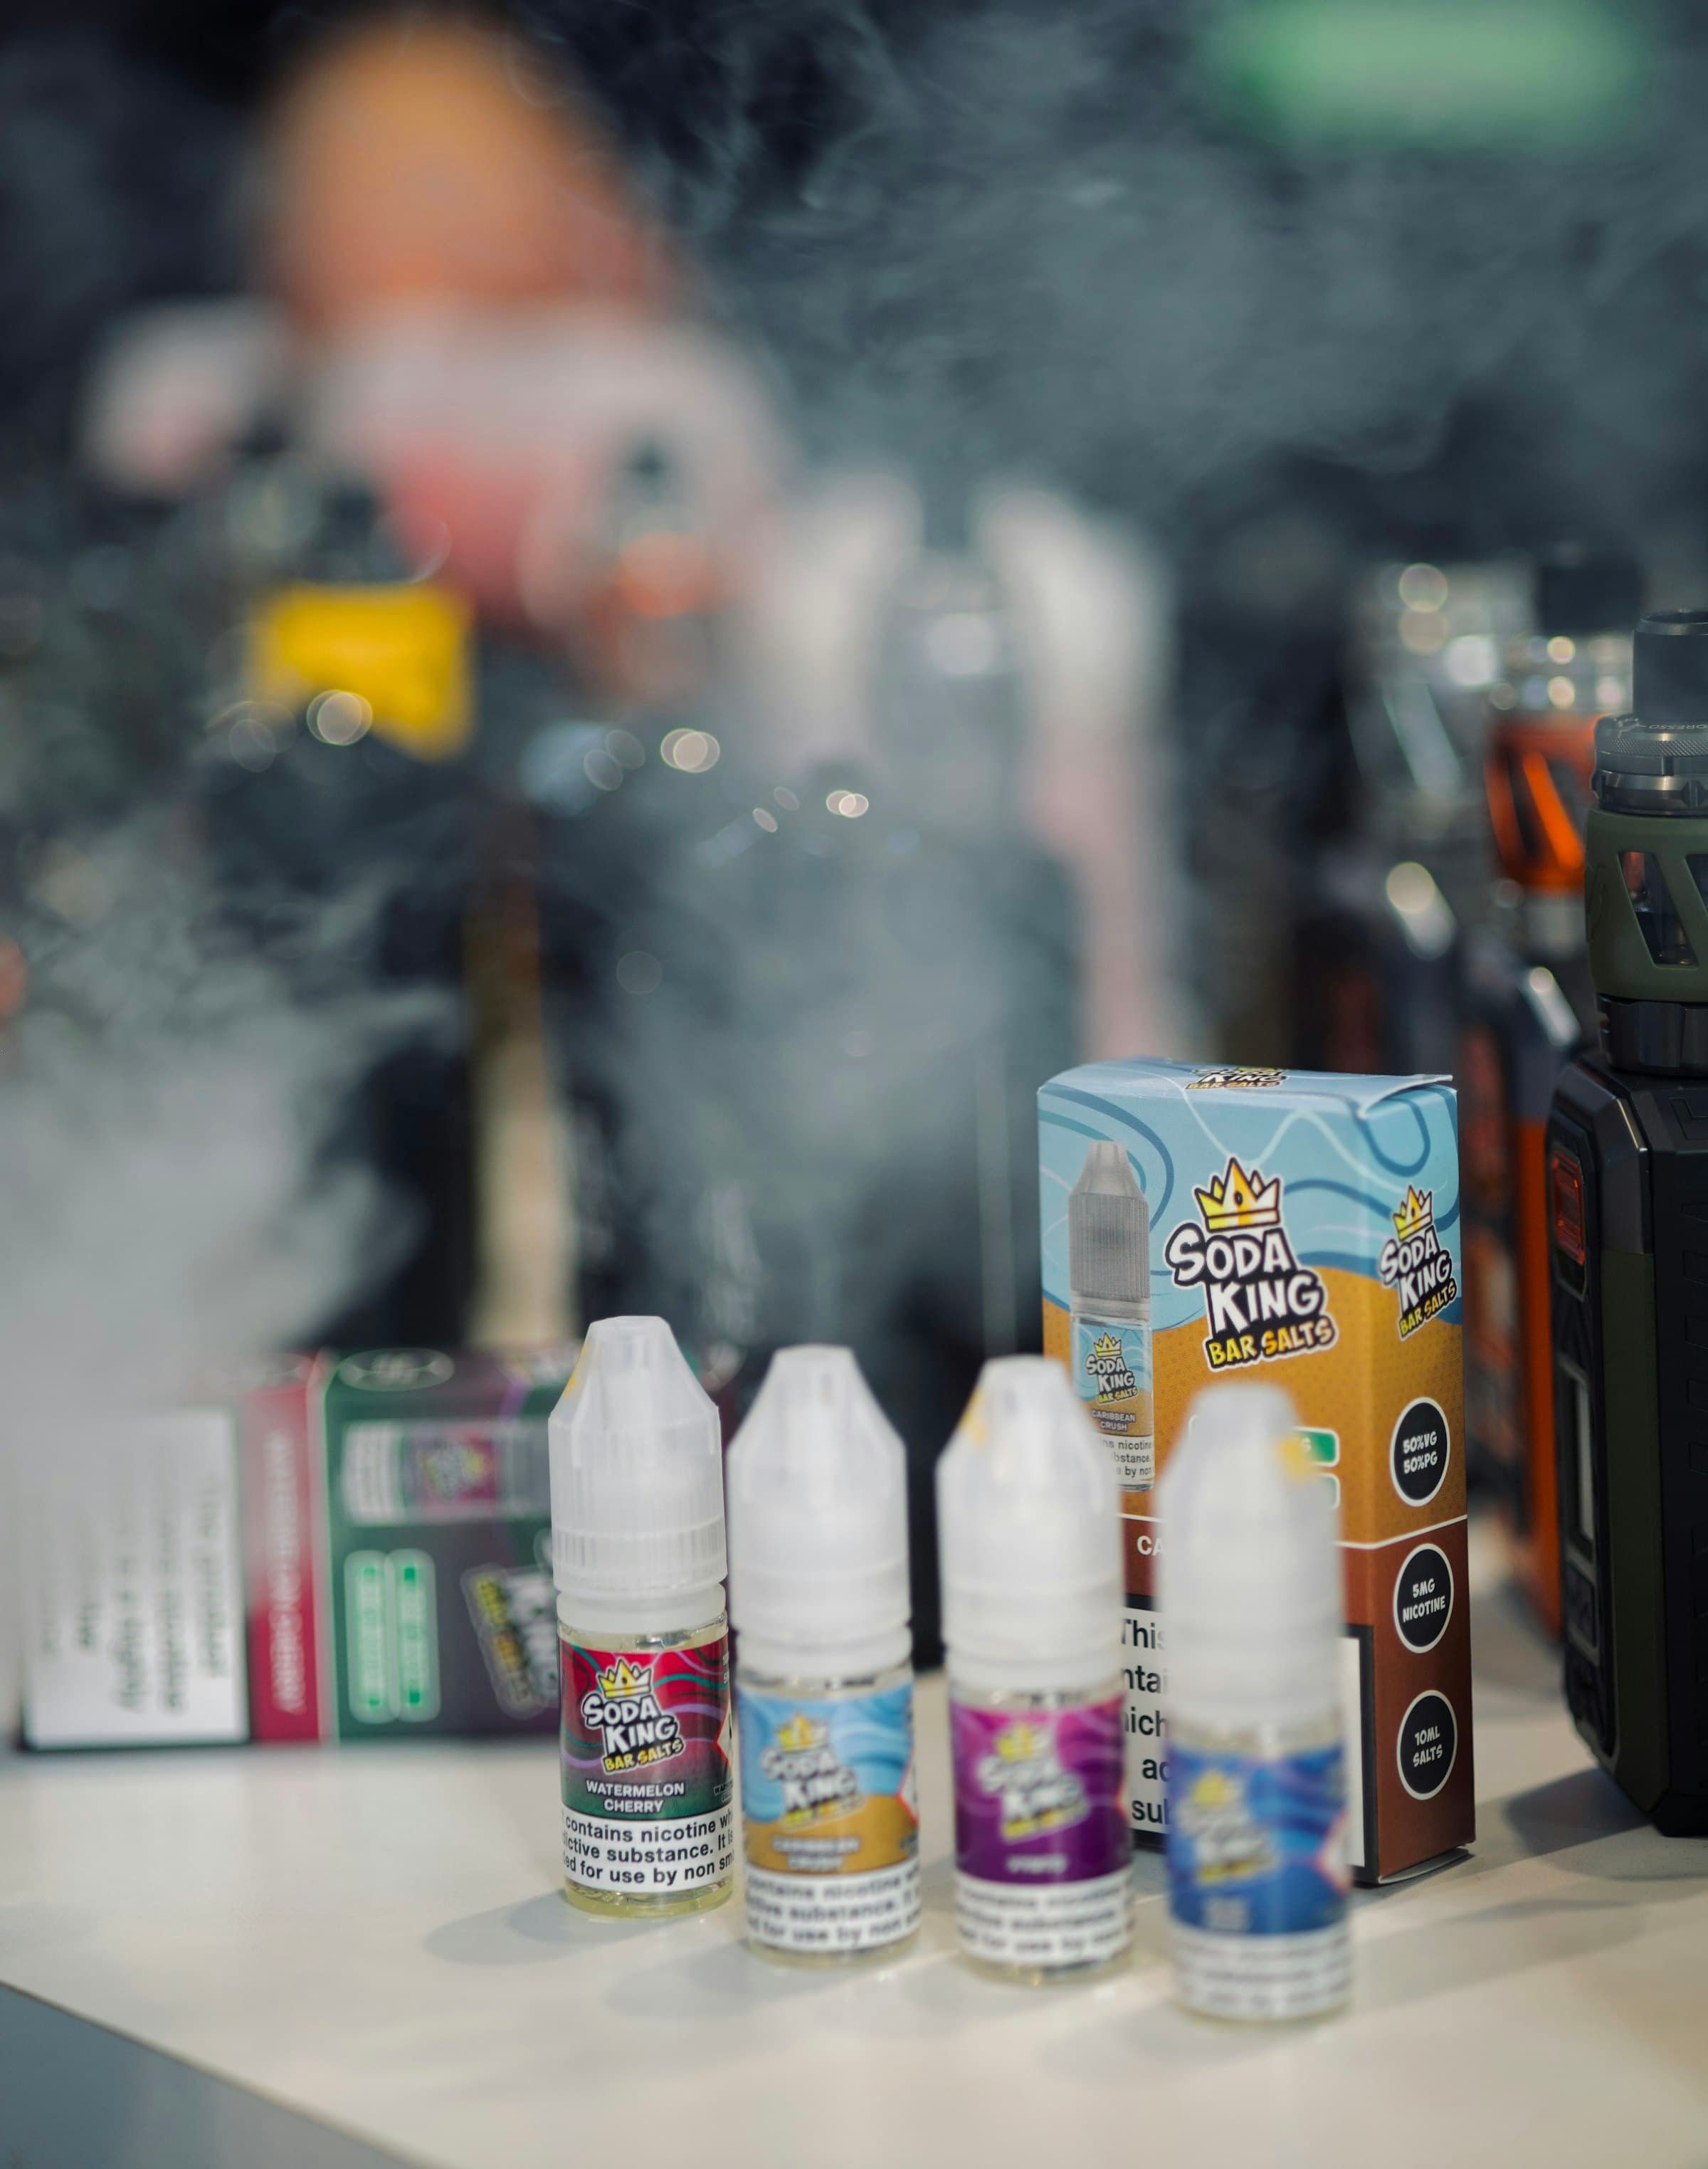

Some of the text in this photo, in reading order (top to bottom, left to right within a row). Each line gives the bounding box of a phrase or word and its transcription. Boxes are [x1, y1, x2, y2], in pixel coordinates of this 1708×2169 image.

[1168, 1227, 1292, 1281] SODA
[1381, 1229, 1438, 1283] SODA
[1401, 1254, 1450, 1312] KING
[1209, 1274, 1321, 1333] KING
[1400, 1281, 1456, 1336] BAR SALTS
[1208, 1317, 1333, 1366] BAR SALTS
[1086, 1355, 1126, 1375] SODA
[1098, 1372, 1134, 1392] KING
[1098, 1387, 1138, 1404] BAR SALTS
[1092, 1409, 1136, 1422] CARIBBEAN
[1100, 1421, 1128, 1432] CRUSH
[1403, 1431, 1438, 1454] 50%VG
[1403, 1451, 1438, 1474] 50%PG
[1412, 1577, 1435, 1598] 5MG
[1403, 1595, 1446, 1623] NICOTINE
[584, 1694, 658, 1726] SODA
[605, 1716, 676, 1755] KING
[1414, 1726, 1440, 1746] 10ML
[604, 1738, 682, 1771] BAR SALTS
[1413, 1744, 1443, 1768] SALTS
[586, 1780, 685, 1797] WATERMELON
[604, 1799, 664, 1813] CHERRY
[566, 1816, 633, 1842] contains
[640, 1821, 716, 1842] nicotine
[606, 1842, 713, 1863] substance.
[718, 1833, 726, 1851] It
[580, 1861, 603, 1879] for
[610, 1869, 645, 1883] use
[653, 1868, 678, 1886] by
[684, 1861, 715, 1880] non
